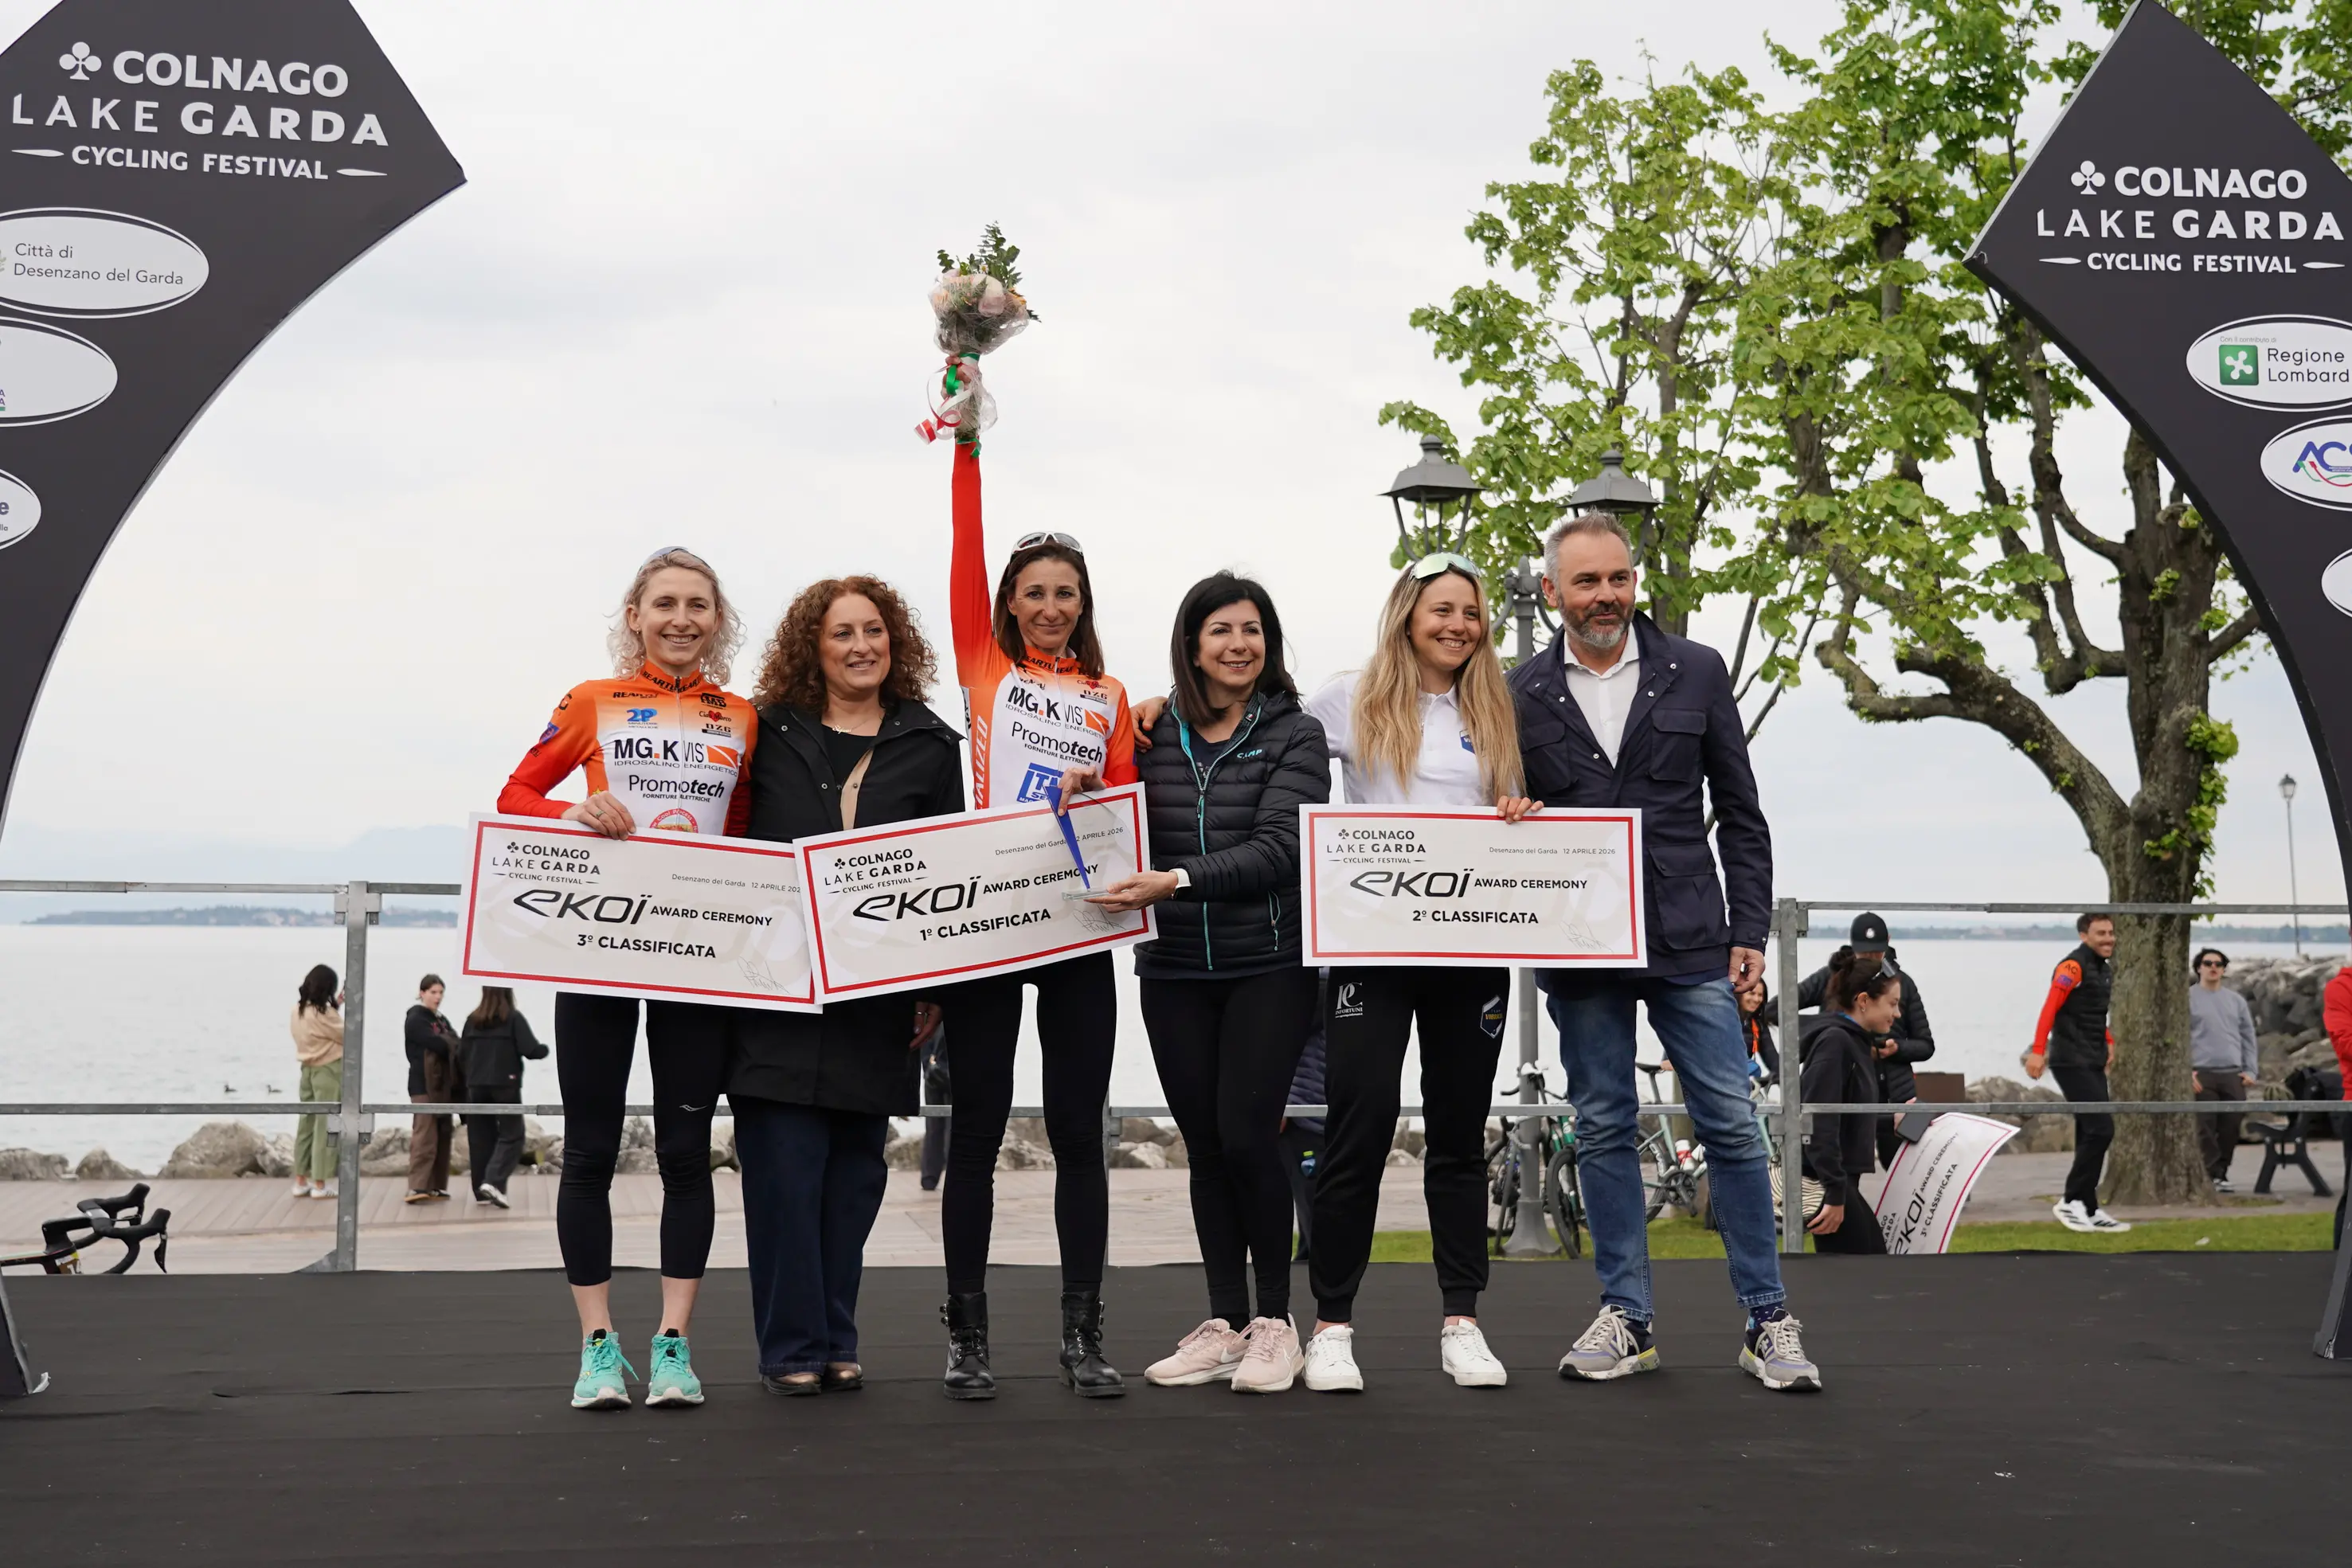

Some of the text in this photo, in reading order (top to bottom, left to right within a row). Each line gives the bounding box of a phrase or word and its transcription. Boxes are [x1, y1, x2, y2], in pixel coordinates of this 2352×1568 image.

[113, 50, 348, 97] COLNAGO
[12, 93, 388, 146] LAKE GARDA
[72, 146, 328, 179] CYCLING FESTIVAL
[2115, 166, 2307, 199] COLNAGO
[2037, 209, 2343, 240] LAKE GARDA
[15, 243, 72, 258] Città di
[2088, 252, 2296, 273] CYCLING FESTIVAL
[14, 263, 183, 285] Desenzano del Garda
[2268, 348, 2344, 366] Regione
[2268, 368, 2349, 382] Lombard
[2292, 441, 2352, 473] AC
[626, 708, 657, 721] 2P
[1005, 703, 1061, 727] IDROSALINO
[1012, 721, 1102, 764] Promotech
[1024, 743, 1059, 758] FORNITURE
[614, 760, 738, 776] IDROSALINO ENERGETICO
[976, 715, 988, 809] IALIZED
[629, 775, 725, 798] Promotech
[657, 811, 671, 821] Cool
[996, 845, 1034, 855] Desenzano
[1082, 831, 1106, 840] APRILE
[1352, 829, 1415, 840] COLNAGO
[522, 844, 590, 860] COLNAGO
[848, 849, 913, 868] COLNAGO
[1326, 843, 1426, 854] LAKE GARDA
[492, 856, 601, 875] LAKE GARDA
[824, 861, 926, 886] LAKE GARDA
[509, 872, 583, 885] CYCLING FESTIVAL
[672, 874, 710, 883] Desenzano
[843, 878, 913, 893] CYCLING FESTIVAL
[983, 879, 1031, 894] AWARD
[1474, 878, 1517, 889] AWARD
[1520, 879, 1587, 889] CEREMONY
[651, 905, 699, 919] AWARD
[702, 911, 773, 926] CEREMONY
[937, 909, 1051, 939] CLASSIFICATA
[1431, 910, 1539, 925] CLASSIFICATA
[598, 936, 716, 959] CLASSIFICATA
[1920, 1166, 1935, 1193] AWARD
[1933, 1132, 1959, 1166] CEREMONY
[1925, 1163, 1958, 1226] CLASSIFICATA
[1884, 1213, 1896, 1242] ARDA
